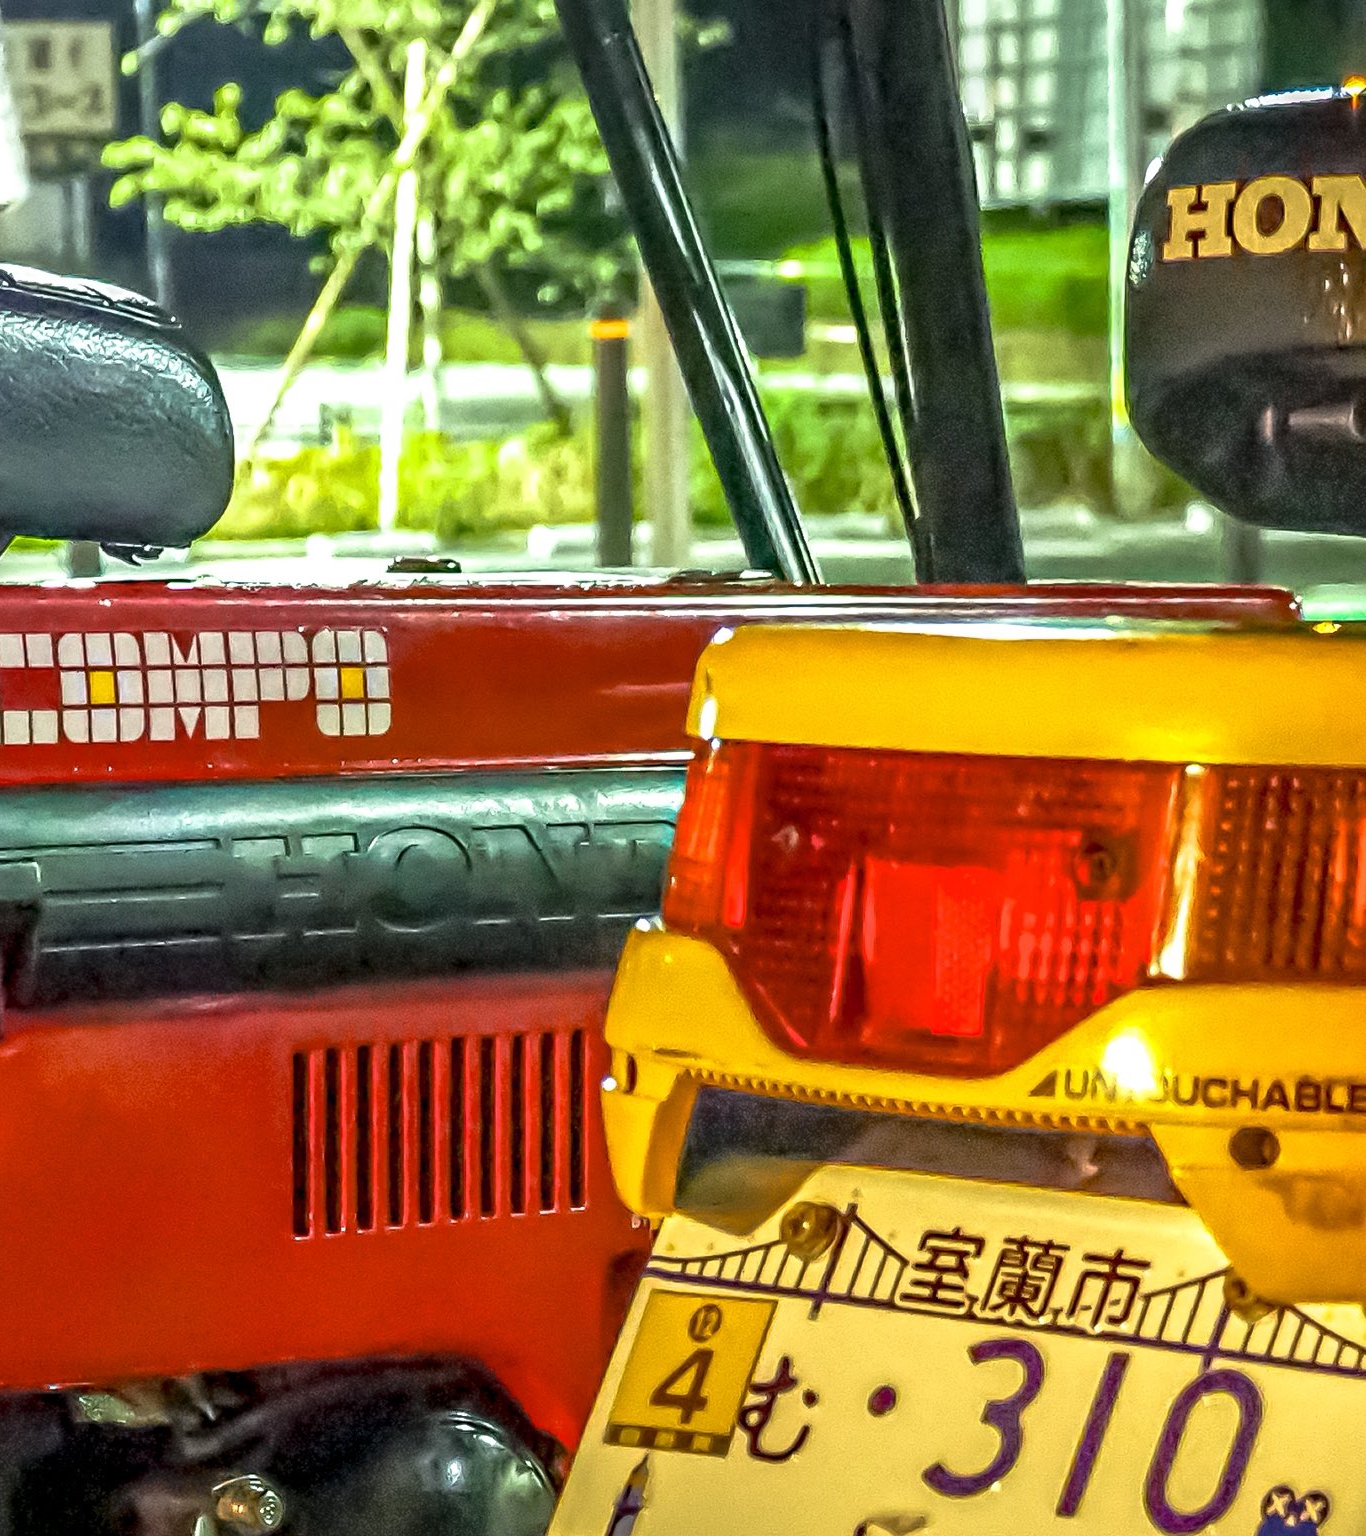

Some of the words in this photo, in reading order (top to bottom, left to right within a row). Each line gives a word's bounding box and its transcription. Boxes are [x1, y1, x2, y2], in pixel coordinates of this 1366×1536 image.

[901, 1227, 1151, 1331] 室蘭市
[649, 1347, 714, 1424] 4
